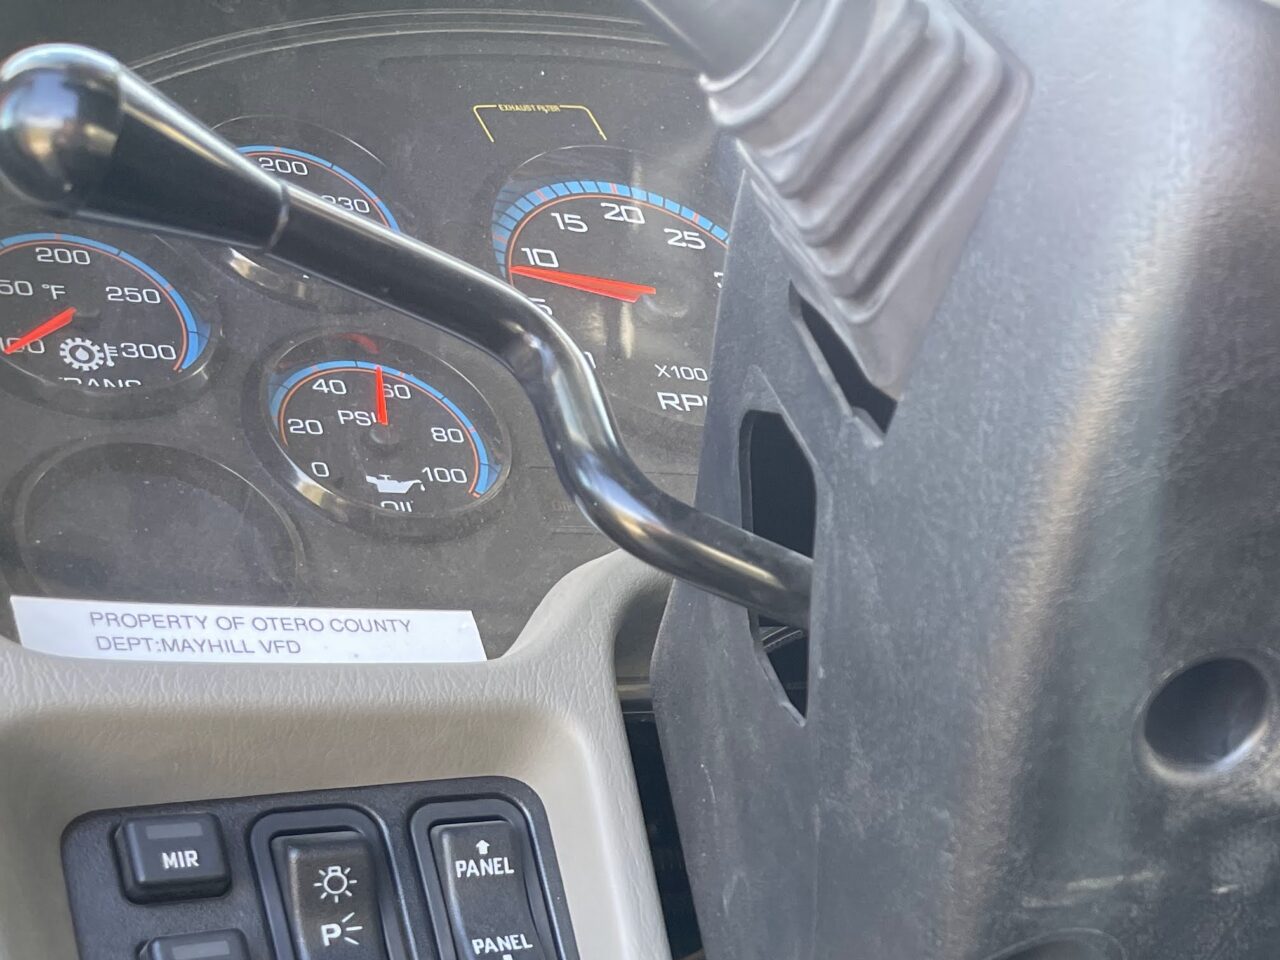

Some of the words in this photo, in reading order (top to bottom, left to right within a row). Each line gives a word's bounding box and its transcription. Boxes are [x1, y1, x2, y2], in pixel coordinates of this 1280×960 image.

[258, 157, 308, 176] 200
[600, 202, 645, 224] 20
[551, 213, 588, 233] 15
[663, 228, 706, 250] 25
[35, 247, 91, 265] 200
[521, 247, 559, 268] 10
[105, 286, 161, 304] 250
[120, 343, 177, 360] 300
[654, 364, 708, 382] X100
[312, 379, 347, 395] 40
[657, 391, 708, 412] RP
[287, 418, 324, 435] 20
[337, 409, 377, 427] PSI
[431, 427, 465, 443] 80
[311, 462, 330, 478] 0
[422, 466, 468, 483] 100
[90, 611, 208, 630] PROPERTY
[215, 615, 245, 631] OF
[251, 616, 325, 632] OTERO
[329, 618, 411, 633] COUNTY
[96, 636, 255, 654] DEPT:MAYHILL
[258, 640, 302, 654] VFD
[162, 850, 199, 869] MIR
[455, 857, 515, 878] PANEL
[320, 923, 342, 946] P
[471, 933, 534, 955] PANEL
